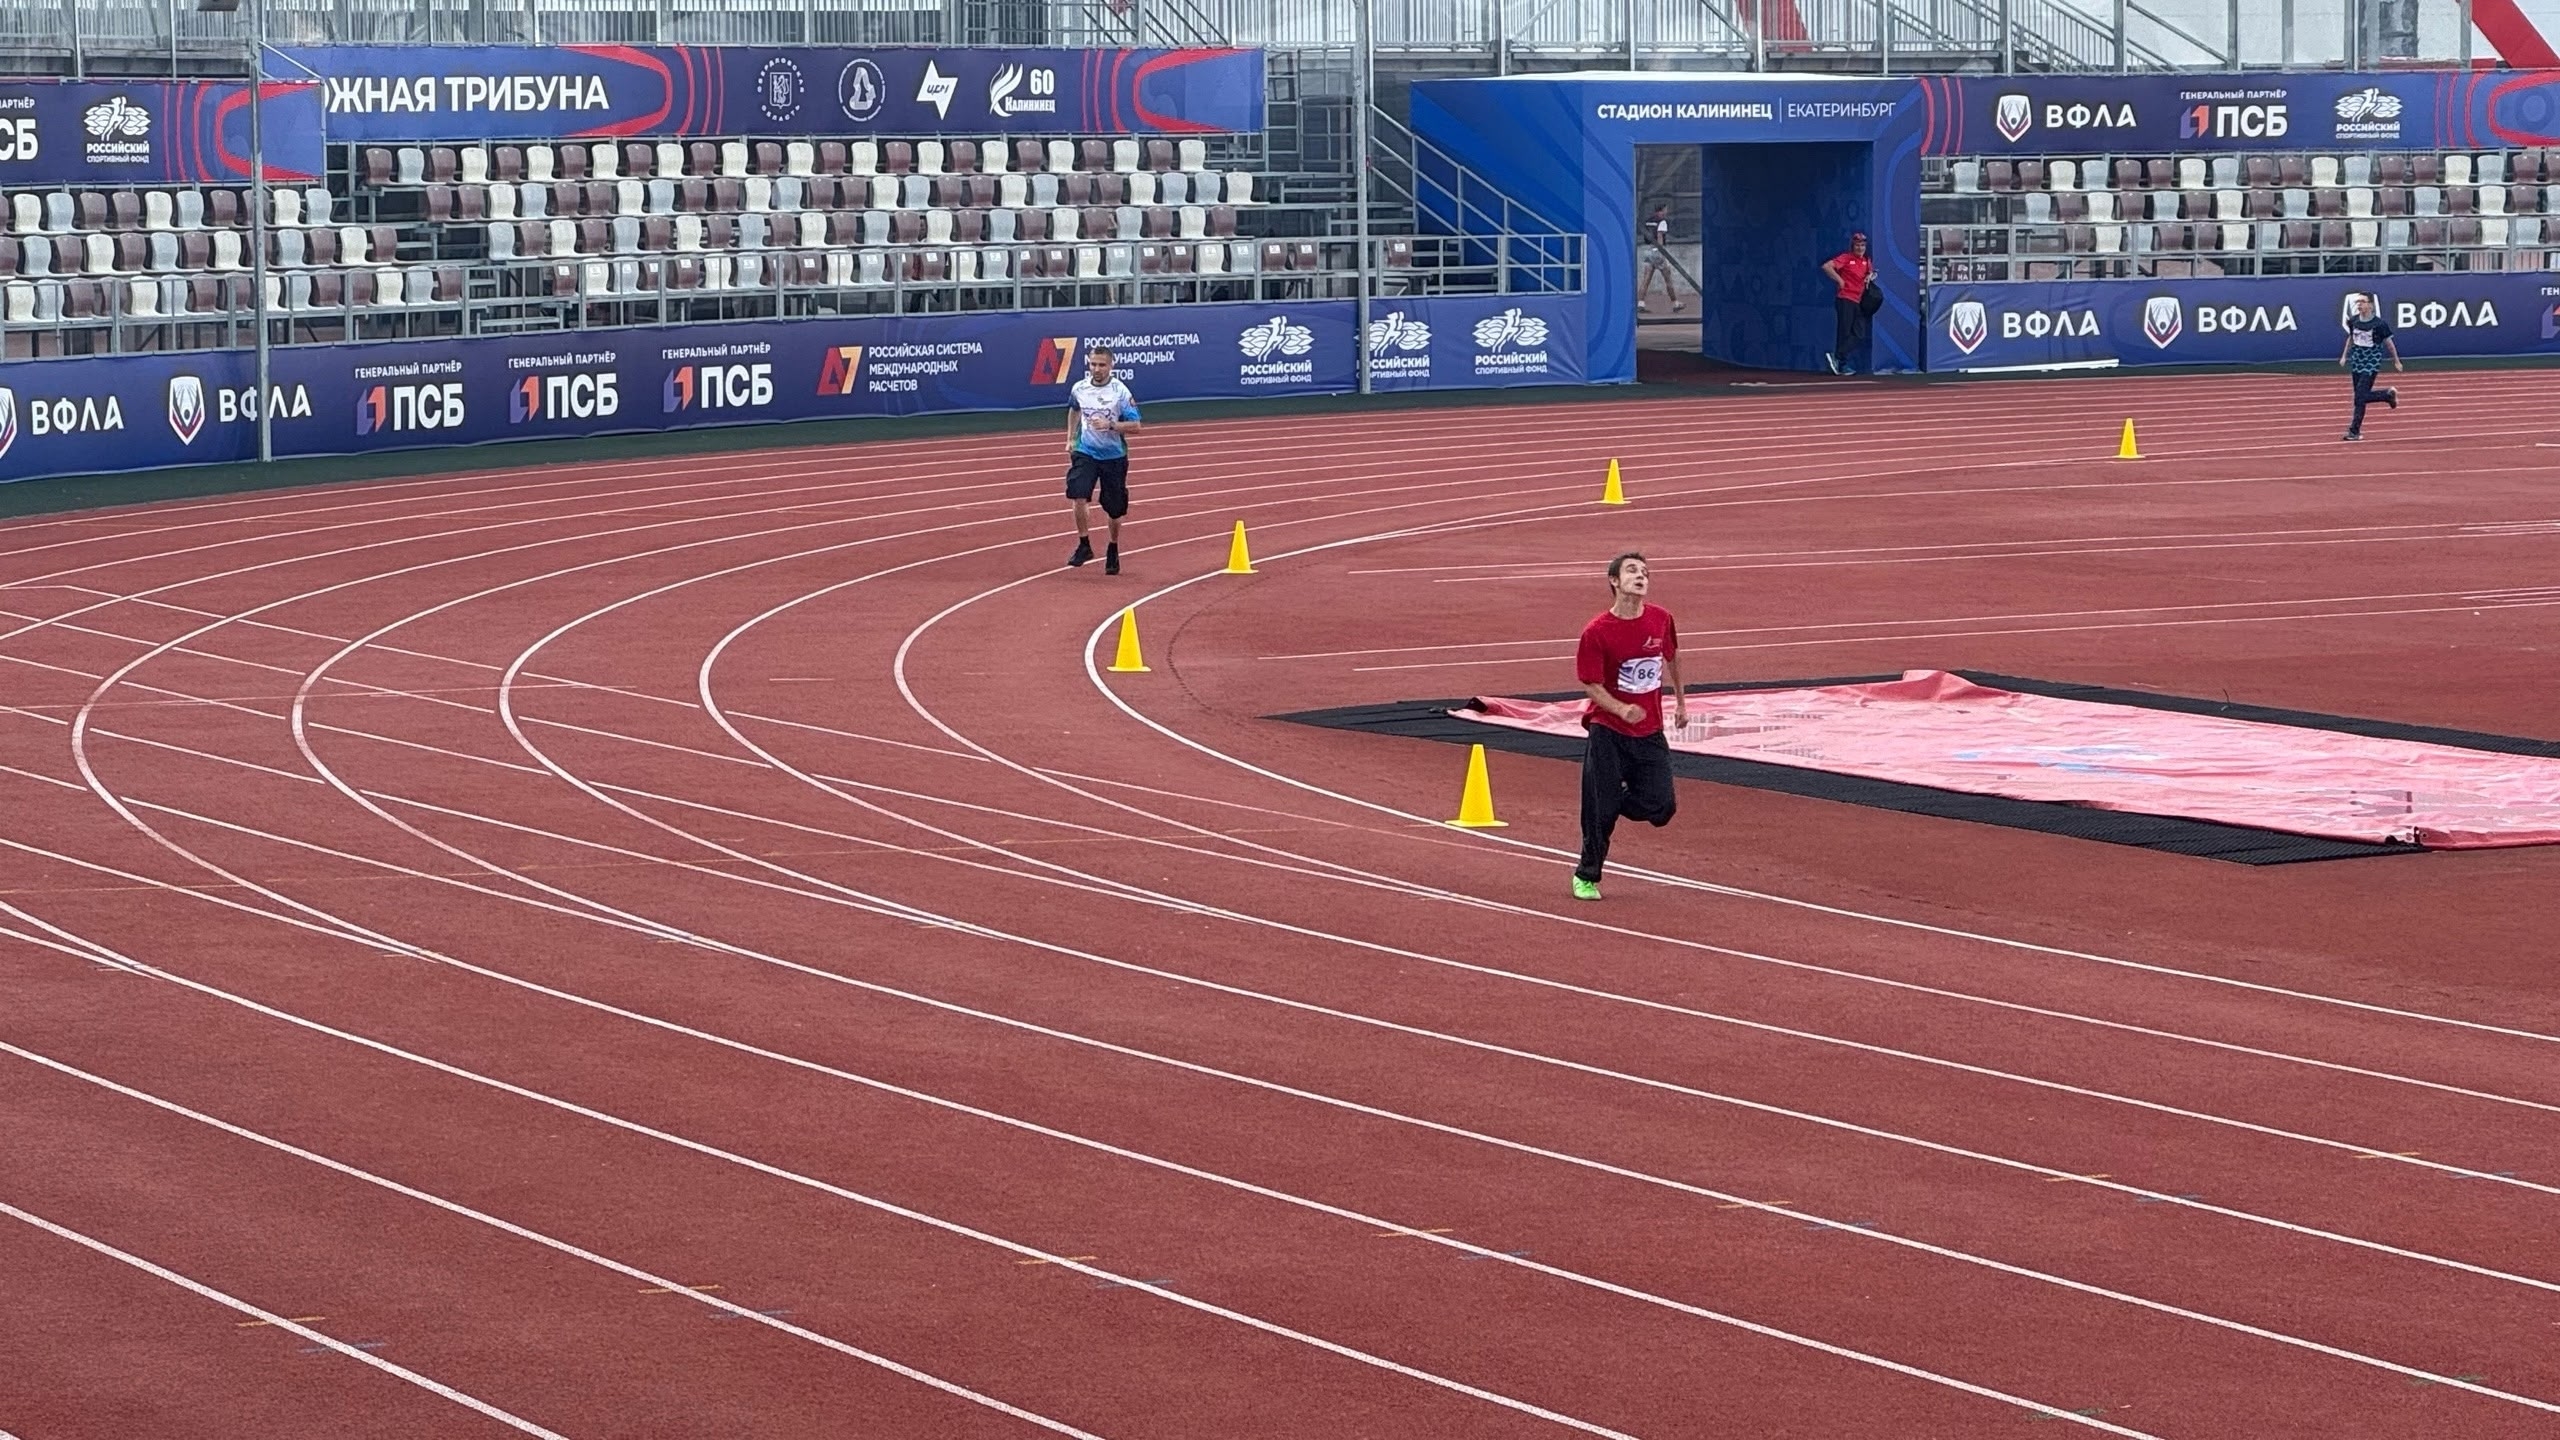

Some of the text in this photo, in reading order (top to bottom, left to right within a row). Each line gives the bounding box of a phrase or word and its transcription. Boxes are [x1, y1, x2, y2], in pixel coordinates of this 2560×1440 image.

[1030, 68, 1055, 95] 60
[325, 75, 610, 113] ЖНАЯ ТРИБУНА
[2180, 88, 2288, 100] ГЕНЕРАЛЬНЫЙ ПАРТНЁР
[1597, 102, 1897, 120] СТАДИОН КАЛИНИНЕЦ ЕКАТЕРИНБУРГ
[2045, 103, 2137, 129] ВФЛА
[2216, 104, 2288, 138] ПСБ
[2336, 121, 2401, 132] РОССИЙСКИЙ
[86, 141, 150, 154] РОССИЙСКИЙ
[2198, 305, 2298, 333] ВФЛА
[2397, 301, 2499, 329] ВФЛА
[2003, 310, 2101, 339] ВФЛА
[1084, 333, 1200, 348] РОССИЙСКАЯ СИСТЕМА
[508, 350, 617, 368] ГЕНЕРАЛЬНЫЙ ПАРТНЁР
[662, 342, 771, 359] ГЕНЕРАЛЬНЫЙ ПАРТНЁР
[869, 341, 982, 359] РОССИЙСКАЯ СИСТЕМА
[1475, 350, 1547, 365] РОССИЙСКИЙ
[355, 360, 462, 378] ГЕНЕРАЛЬНЫЙ ПАРТНЁР
[869, 361, 958, 375] МЕЖДУНАРОДНЫХ
[1241, 360, 1312, 375] РОССИЙСКИЙ
[1408, 369, 1430, 378] ФОНД
[1475, 364, 1547, 375] СПОРТИВНЫЙ ФОНД
[700, 363, 774, 408] ПСБ
[869, 379, 918, 393] РАСЧЕТОВ
[1241, 374, 1312, 385] СПОРТИВНЫЙ ФОНД
[547, 373, 619, 419] ПСБ
[31, 396, 124, 435] ВФЛА
[393, 383, 465, 431] ПСБ
[1638, 668, 1655, 679] 86
